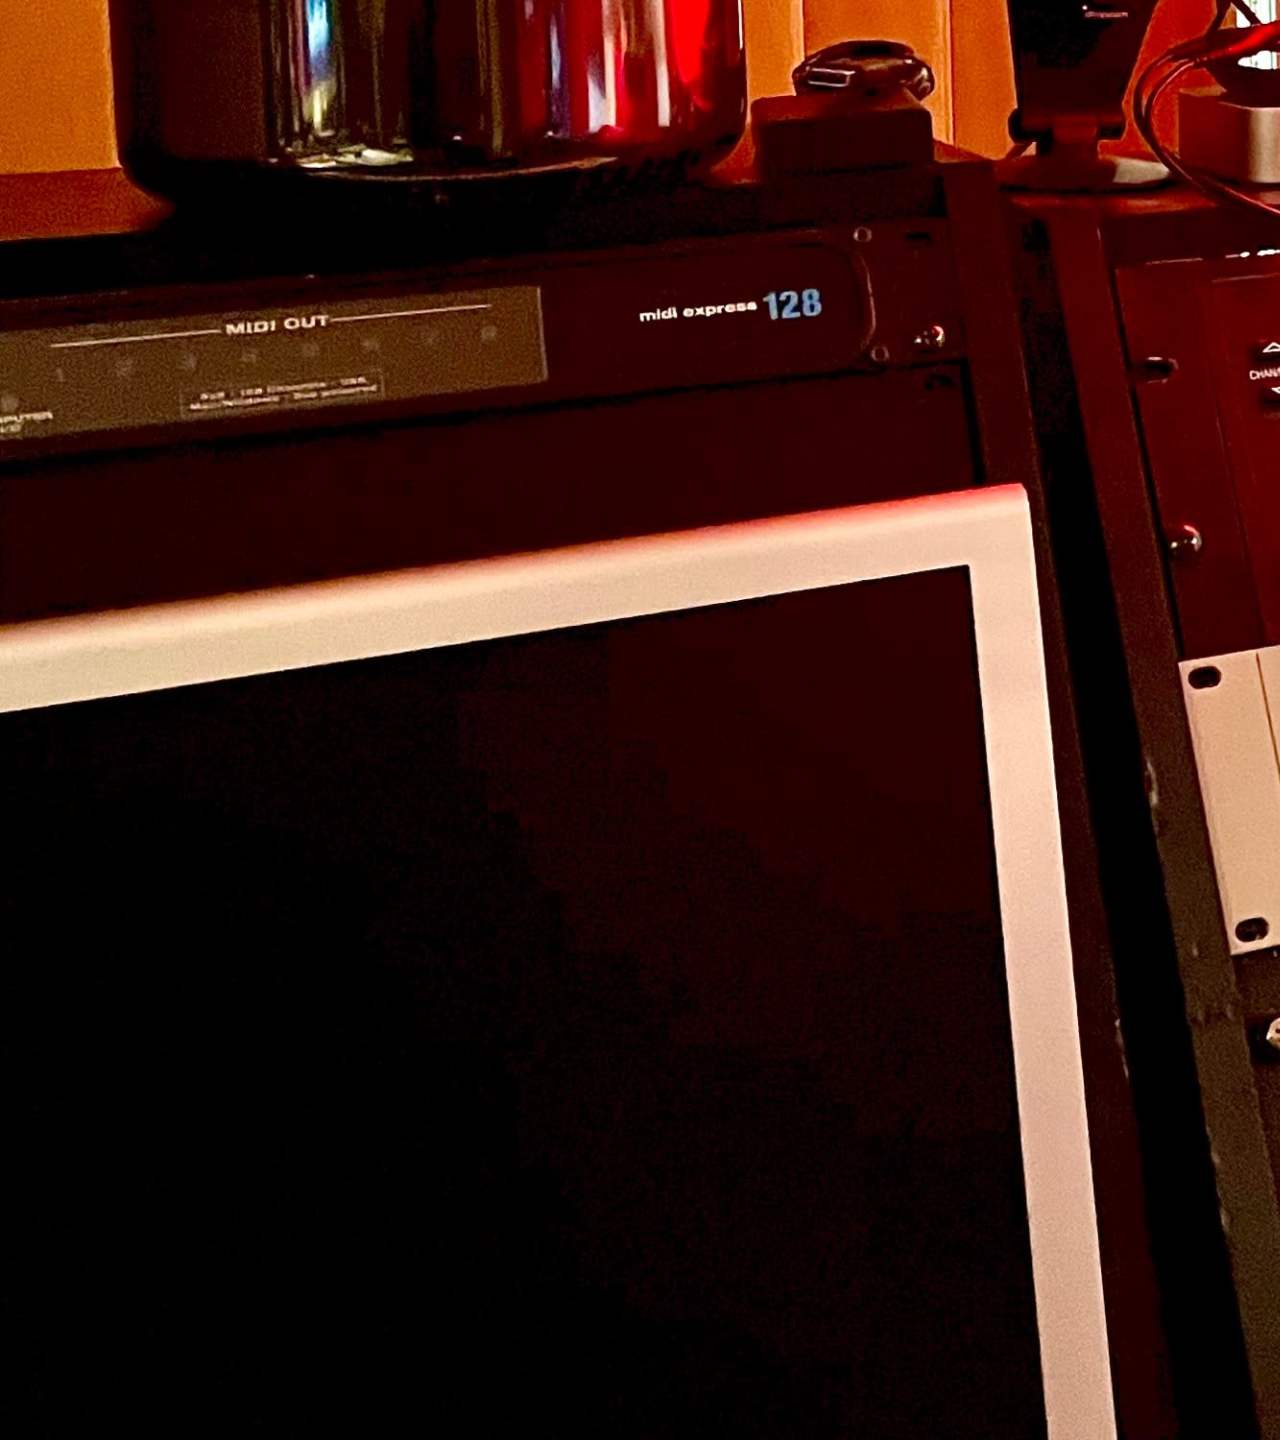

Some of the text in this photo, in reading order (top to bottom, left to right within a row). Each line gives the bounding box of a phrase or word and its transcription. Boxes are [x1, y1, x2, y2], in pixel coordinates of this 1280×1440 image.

[639, 288, 822, 322] midi express 128
[225, 315, 330, 336] MIDI OUT
